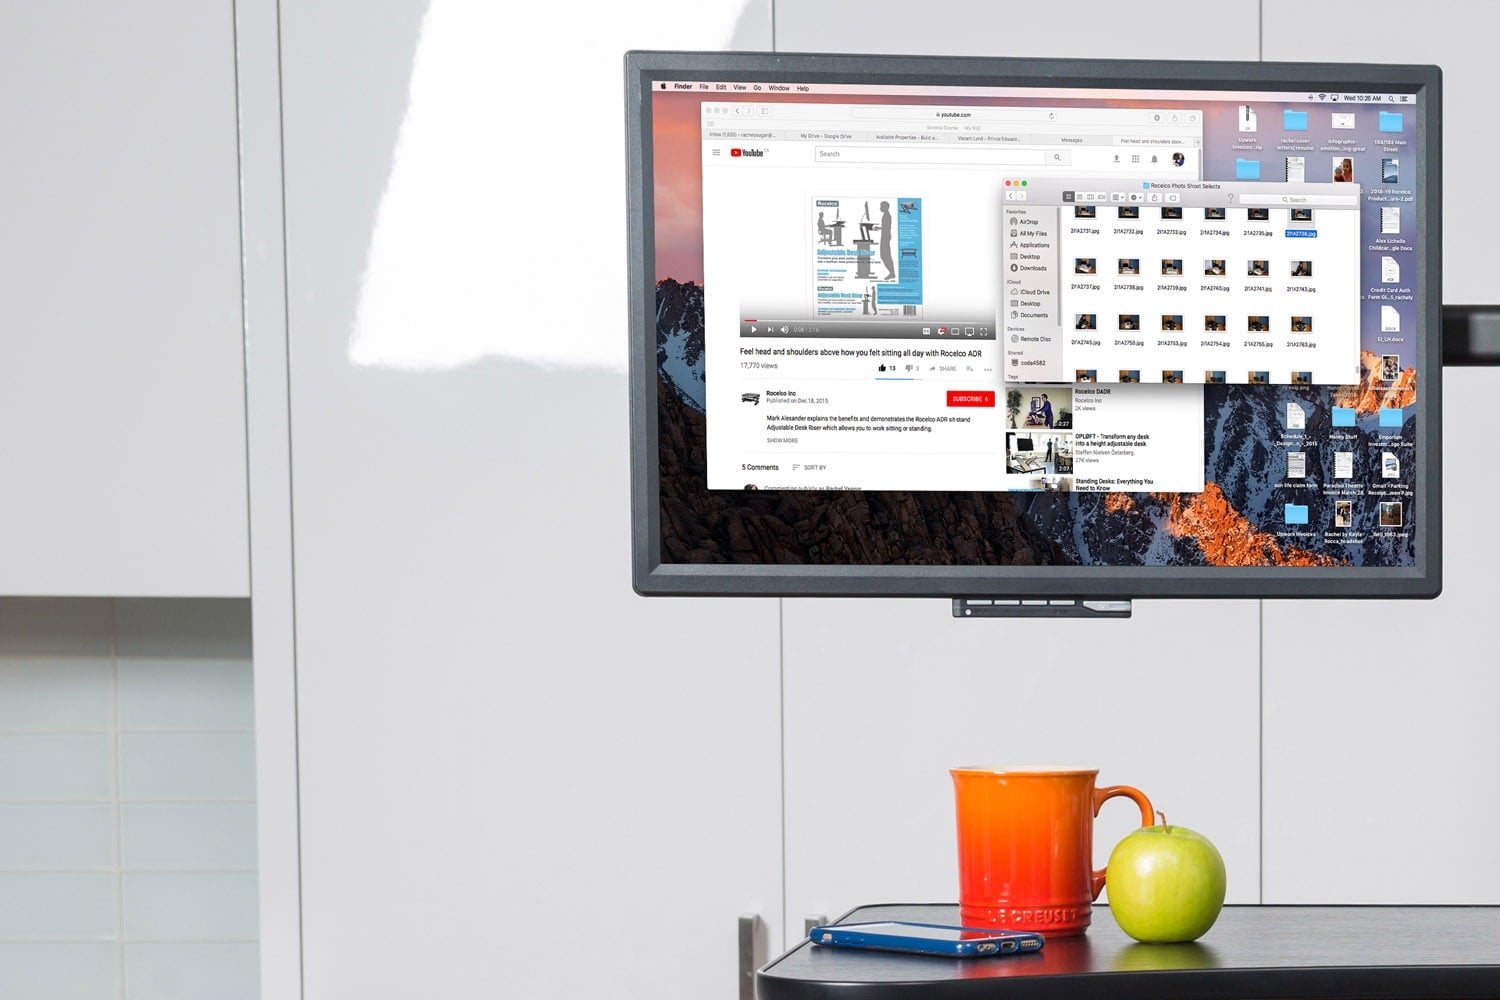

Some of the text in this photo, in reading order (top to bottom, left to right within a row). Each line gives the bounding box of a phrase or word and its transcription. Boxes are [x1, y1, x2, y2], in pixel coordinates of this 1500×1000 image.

[741, 149, 763, 157] YouTube
[786, 348, 818, 356] shoulders
[881, 349, 902, 358] sitting
[912, 349, 924, 358] day
[925, 349, 939, 357] with
[1010, 909, 1079, 924] CREUSET
